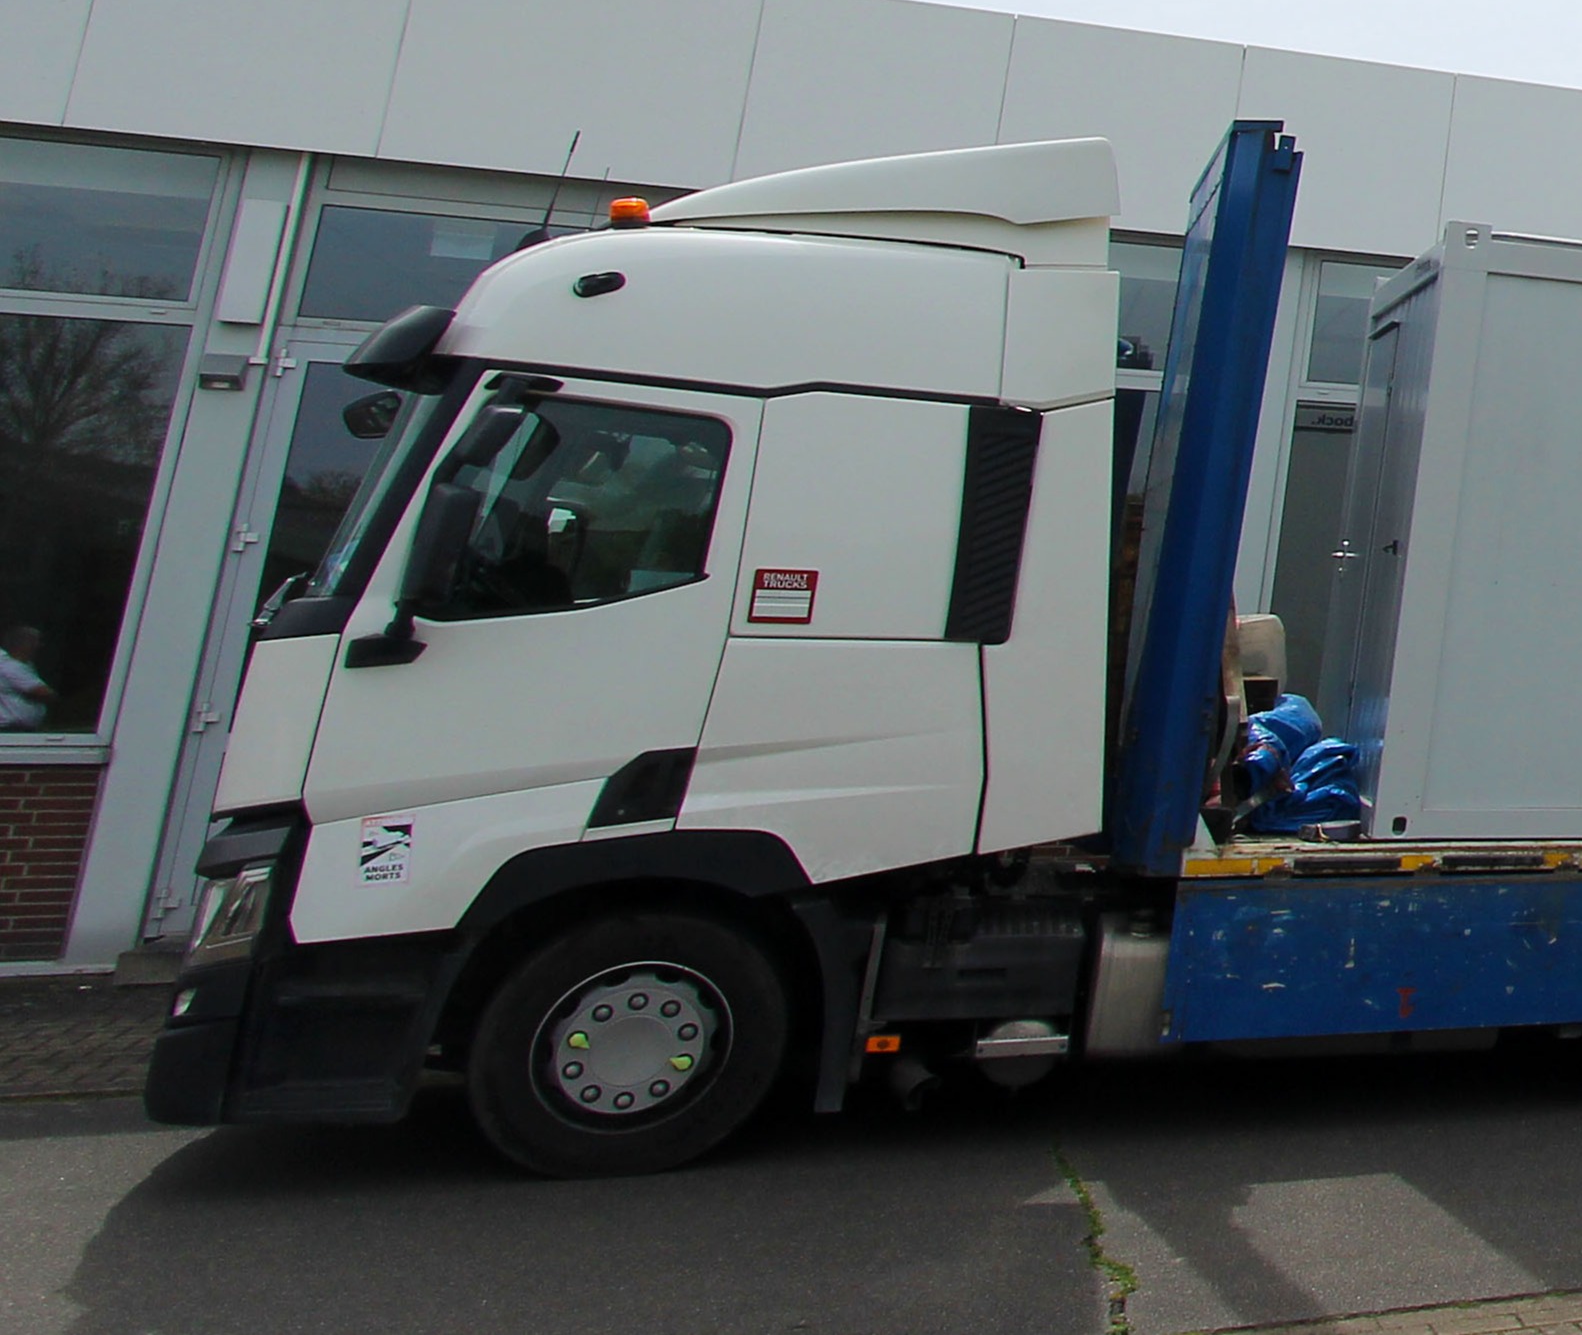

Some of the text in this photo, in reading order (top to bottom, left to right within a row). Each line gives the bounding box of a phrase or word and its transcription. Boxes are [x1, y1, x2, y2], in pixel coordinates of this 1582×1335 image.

[763, 572, 808, 583] RENAULT
[764, 580, 807, 589] TRUCKS
[364, 864, 403, 874] ANGLES
[365, 872, 401, 881] MORTS
